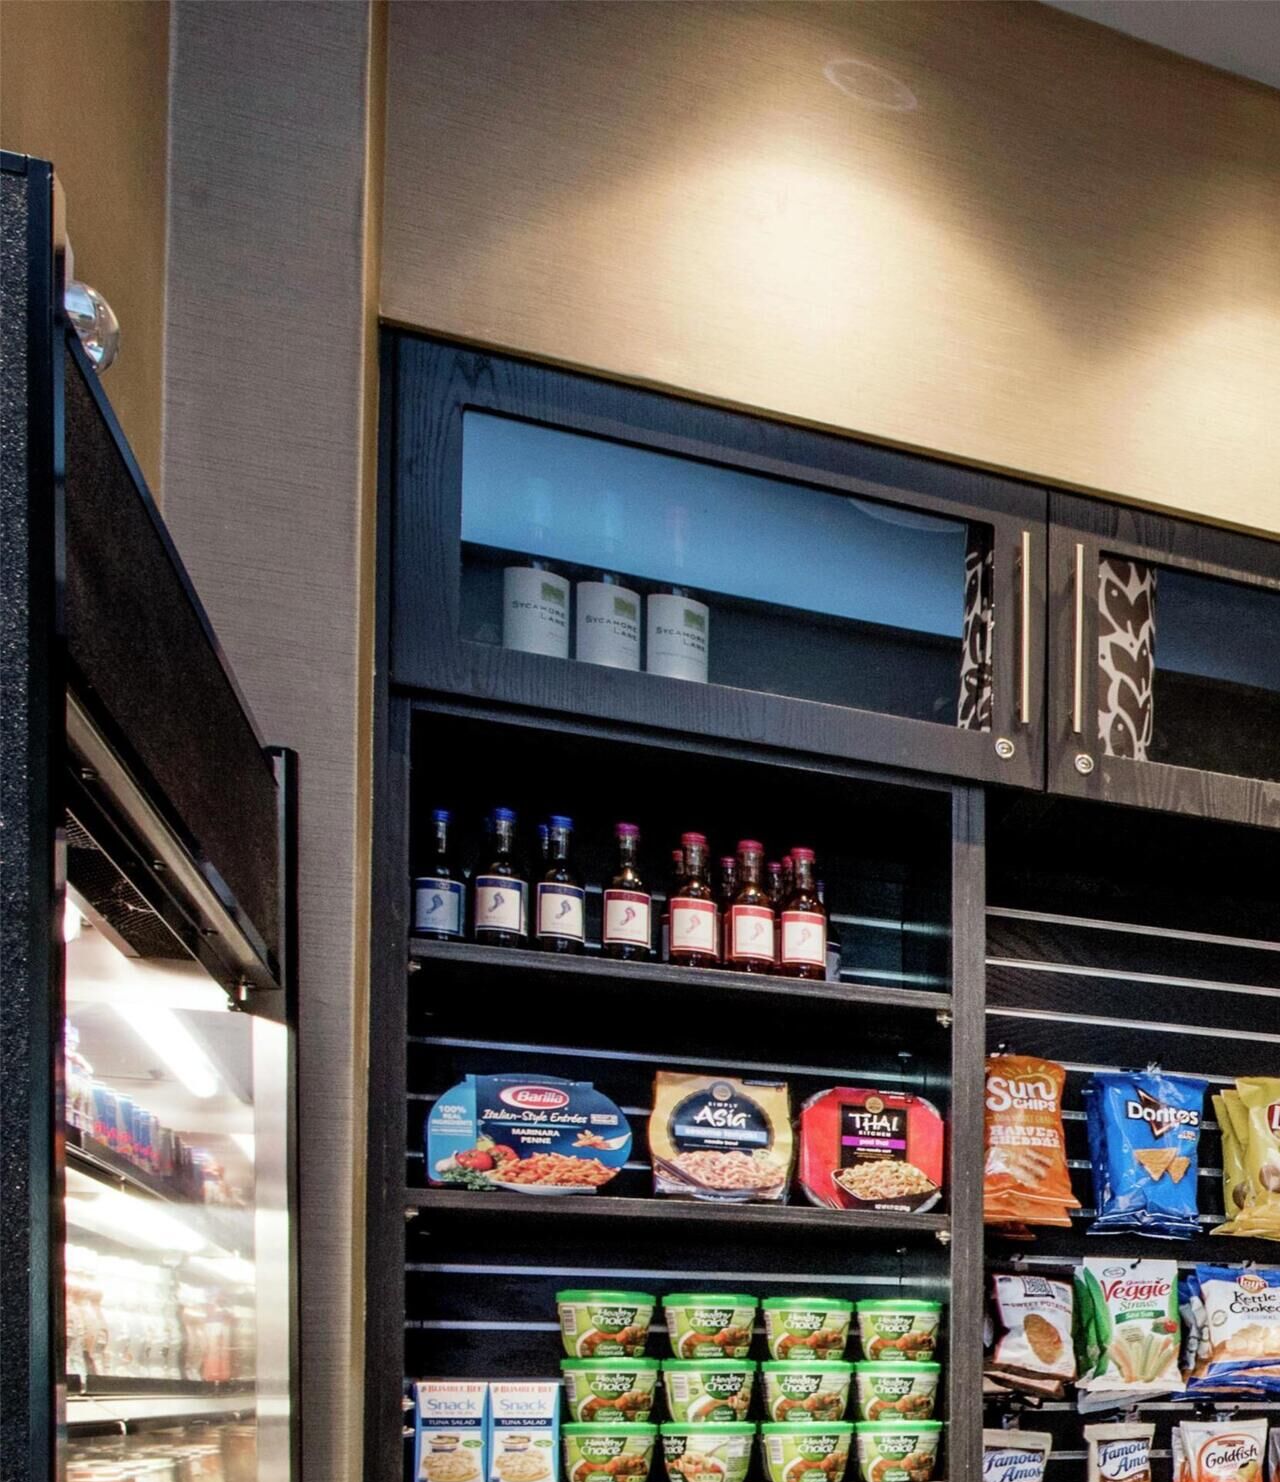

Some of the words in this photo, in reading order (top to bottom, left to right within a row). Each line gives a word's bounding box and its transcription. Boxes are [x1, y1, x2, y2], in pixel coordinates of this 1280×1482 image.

[512, 600, 566, 619] SYCAMORE
[585, 614, 638, 633] SYCAMORE
[613, 626, 638, 642] LANE
[656, 626, 705, 643] SYCAMORE
[516, 1090, 564, 1104] Barilla
[986, 1073, 1057, 1112] Sun
[1012, 1098, 1056, 1113] CHIPS
[693, 1106, 748, 1129] Asia
[1127, 1101, 1199, 1127] Doritos
[849, 1112, 899, 1132] THAI
[511, 1128, 561, 1137] MARINARA
[858, 1130, 892, 1138] KITCHEN
[520, 1136, 552, 1145] PENNE
[1100, 1277, 1171, 1301] Veggie
[1120, 1298, 1159, 1310] Straws
[1233, 1291, 1277, 1304] Kettle
[591, 1314, 632, 1326] Choice
[689, 1316, 729, 1327] Choice
[784, 1319, 823, 1330] Choice
[590, 1380, 631, 1392] Choice
[427, 1399, 476, 1411] Snack
[500, 1399, 546, 1411] Snack
[584, 1437, 624, 1447] Healthy
[580, 1444, 621, 1456] Choice
[1205, 1444, 1258, 1469] Goldfish
[983, 1453, 1043, 1472] Famous
[1110, 1456, 1150, 1477] Amo
